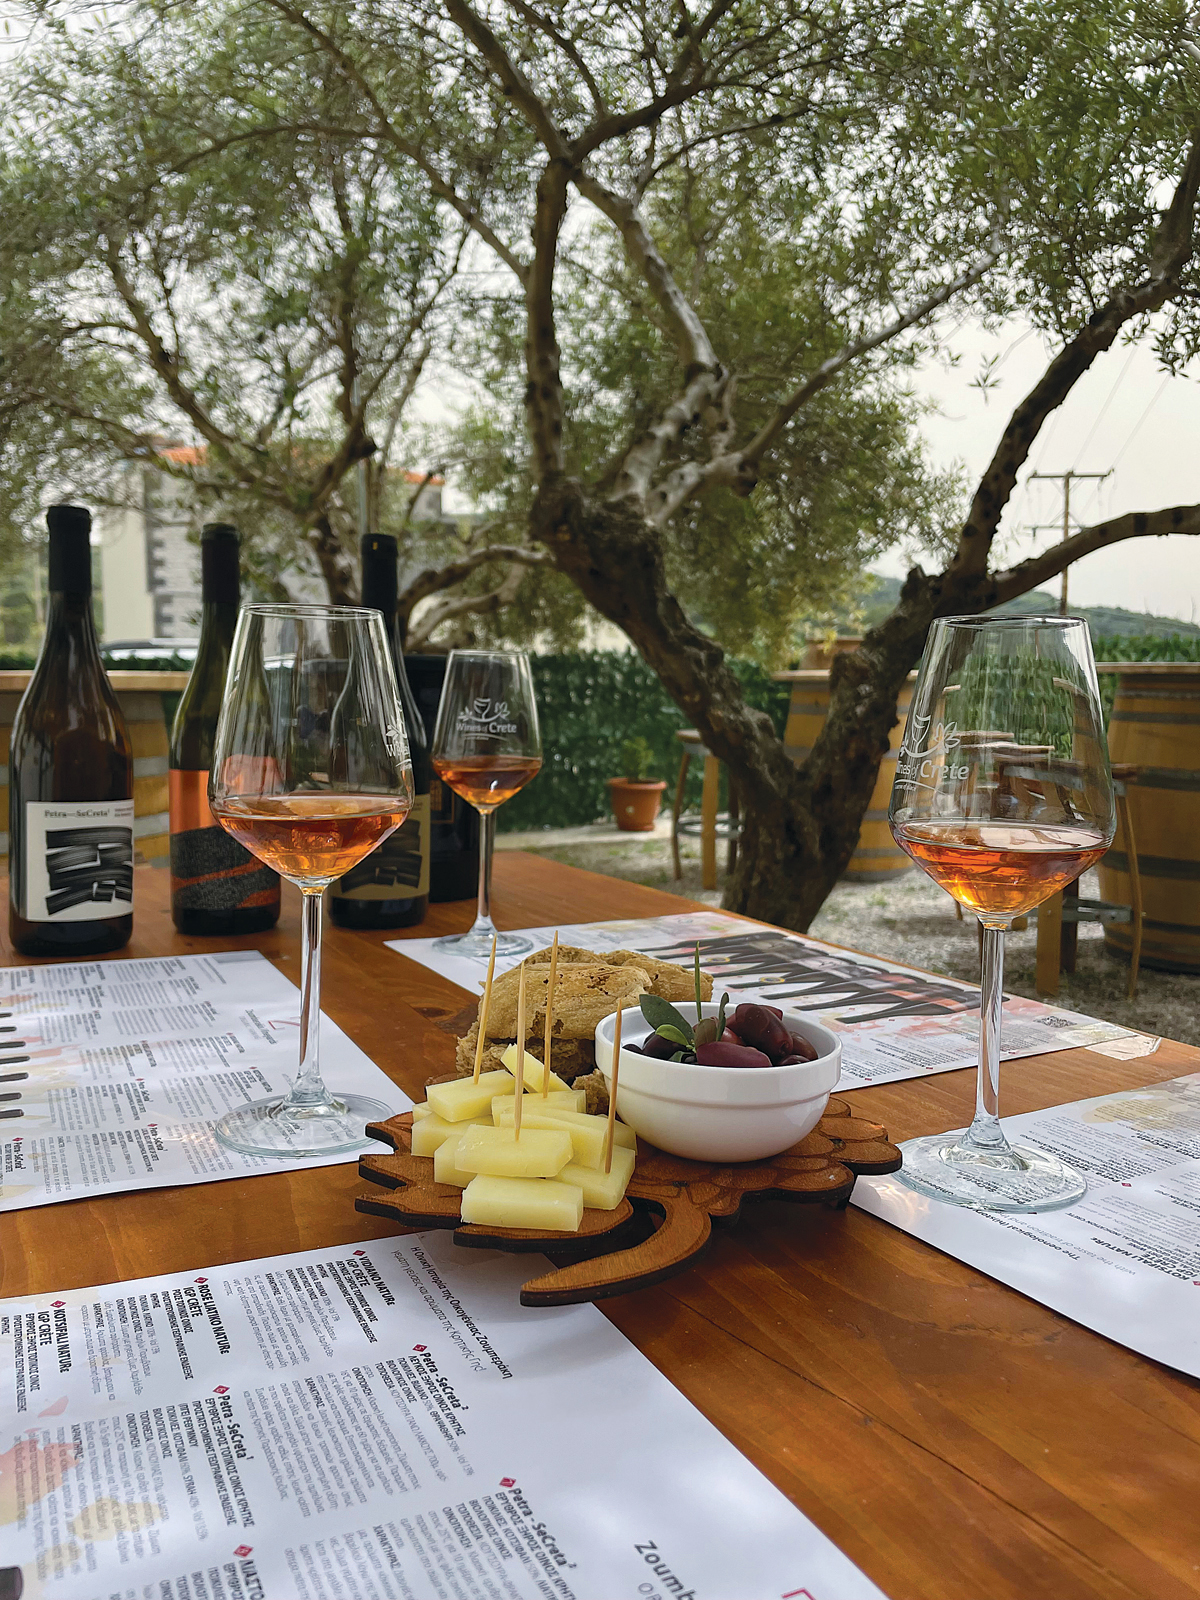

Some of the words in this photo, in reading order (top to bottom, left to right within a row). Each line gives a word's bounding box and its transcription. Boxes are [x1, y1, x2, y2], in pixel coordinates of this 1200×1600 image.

[489, 722, 517, 733] Crete
[920, 760, 969, 780] Crete
[1008, 1225, 1062, 1250] oenological
[344, 1258, 359, 1268] IGP
[1062, 1250, 1080, 1261] The
[350, 1268, 372, 1287] CRÈTE
[357, 1256, 381, 1281] VIDIANO
[423, 1268, 449, 1289] Ιστορία
[1131, 1255, 1190, 1280] KOTSIFALI
[181, 1286, 196, 1298] IGP
[196, 1284, 212, 1301] ROSE
[438, 1288, 456, 1300] της
[35, 1310, 50, 1323] IGP
[185, 1297, 206, 1317] CRÈTE
[202, 1300, 221, 1326] LIATIKO
[445, 1299, 484, 1336] Οικογένειας
[37, 1322, 55, 1345] CRÈTE
[51, 1308, 69, 1344] KOTSIFALI
[418, 1352, 440, 1373] Petra
[472, 1335, 515, 1379] Ζουμπεράκη
[216, 1394, 235, 1418] Petra
[400, 1386, 418, 1403] ΟΙΝΟΣ
[407, 1354, 428, 1376] ΛΕΥΚΟΣ
[419, 1375, 439, 1394] ΞΗΡΟΣ
[431, 1393, 451, 1412] ΟΙΝΟΣ
[442, 1411, 466, 1436] ΚΡΗΤΗΣ
[204, 1397, 221, 1425] ΕΡΥΘΡΟΣ
[212, 1424, 228, 1447] ΞΗΡΟΣ
[219, 1446, 237, 1475] ΤΟΠΙΚΟΣ
[228, 1474, 245, 1497] ΟΙΝΟΣ
[235, 1496, 254, 1527] ΚΡΗΤΗΣ
[506, 1487, 536, 1516] Petra
[493, 1491, 525, 1526] ΕΡΥΘΡΟΣ
[515, 1524, 542, 1552] ΞΗΡΟΣ
[533, 1550, 559, 1578] ΟΙΝΟΣ
[490, 1536, 513, 1560] ΟΙΝΟΣ
